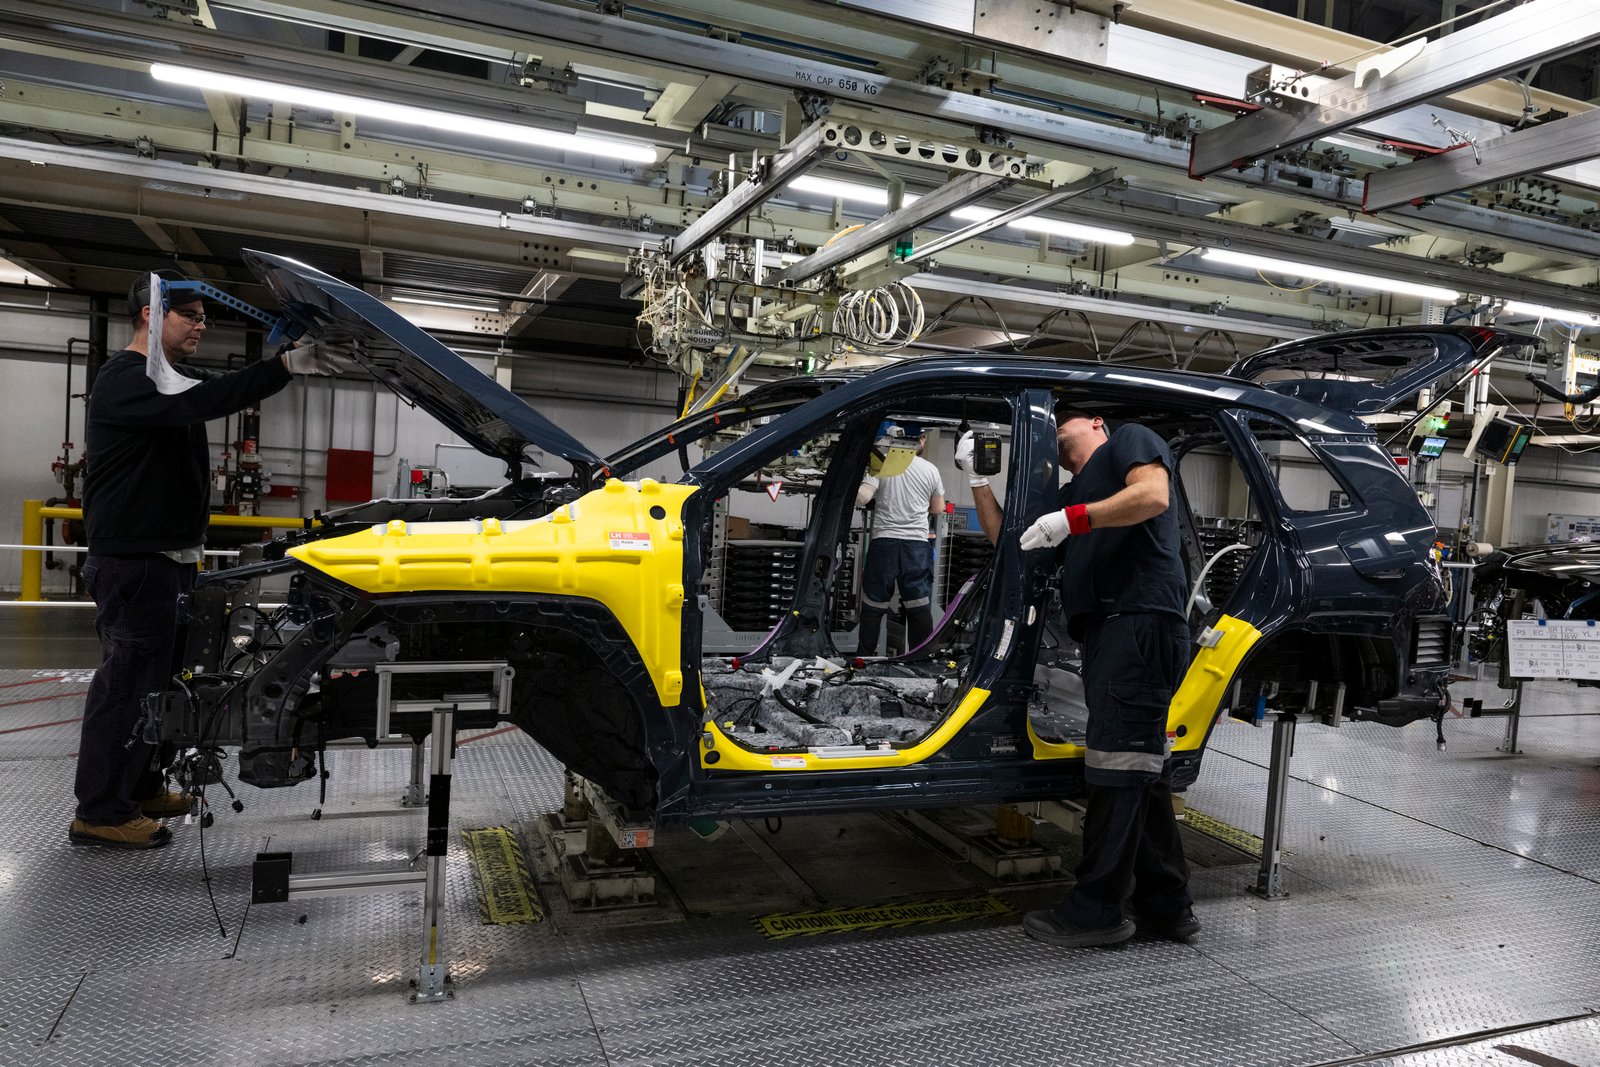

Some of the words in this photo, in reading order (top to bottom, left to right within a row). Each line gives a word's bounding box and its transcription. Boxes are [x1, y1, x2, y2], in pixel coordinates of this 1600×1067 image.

[795, 71, 812, 82] MAX
[816, 76, 834, 86] CAP
[838, 79, 858, 91] 650
[863, 84, 877, 95] KG
[688, 336, 720, 344] HOUSIN
[1555, 668, 1570, 676] 876
[770, 913, 835, 931] CAUTION!
[836, 909, 889, 925] VEHICLE
[891, 904, 951, 920] CHANGES
[951, 899, 997, 915] HEIGHT
